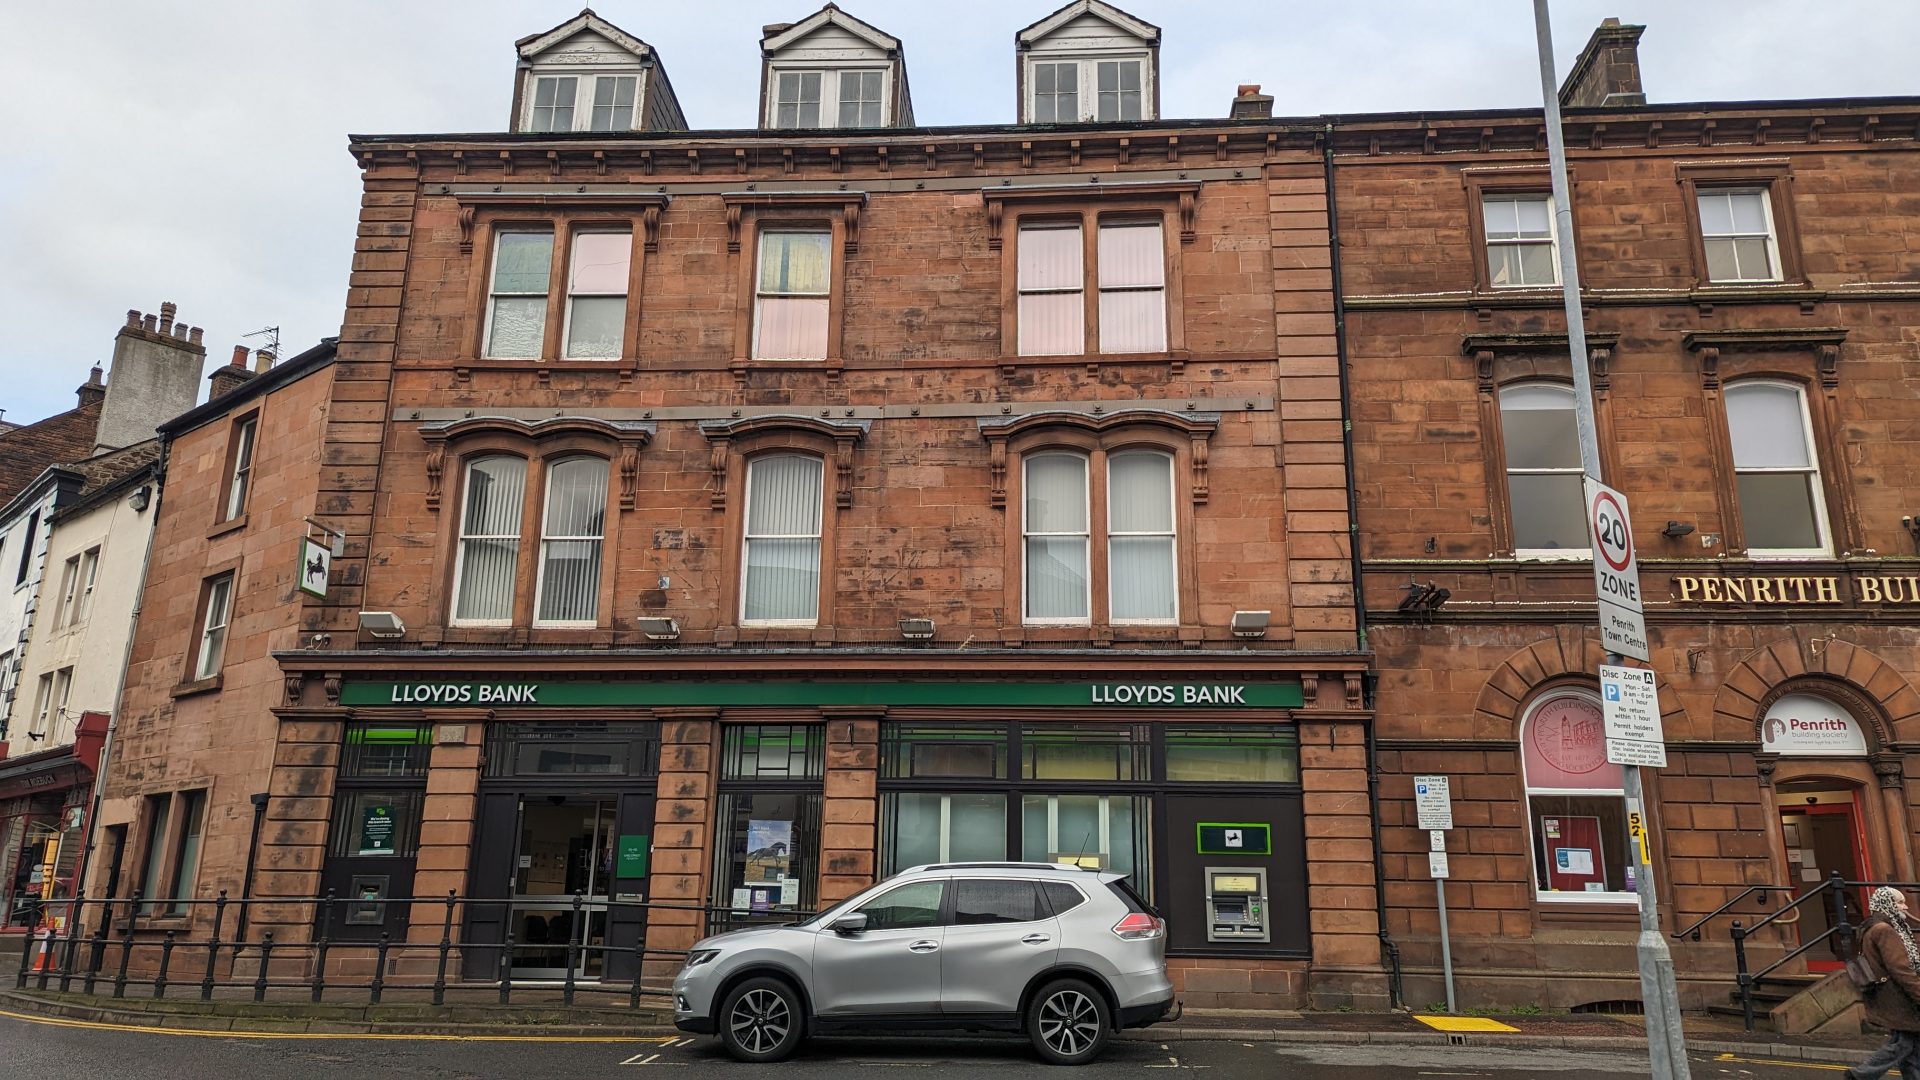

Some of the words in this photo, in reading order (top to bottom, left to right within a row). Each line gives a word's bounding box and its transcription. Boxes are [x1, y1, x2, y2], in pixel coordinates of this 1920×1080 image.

[1600, 512, 1626, 550] 20
[1600, 571, 1637, 602] ZONE
[1676, 576, 1841, 603] PENRITH
[1612, 615, 1636, 632] Penrith
[1604, 626, 1622, 643] Town
[1624, 635, 1647, 650] Centre
[1602, 670, 1619, 678] Disc
[1623, 672, 1642, 680] Zone
[392, 684, 472, 702] LLOYDS
[478, 684, 538, 702] BANK
[1092, 685, 1176, 703] LLOYDS
[1183, 685, 1246, 704] BANK
[1790, 718, 1847, 730] Penrith
